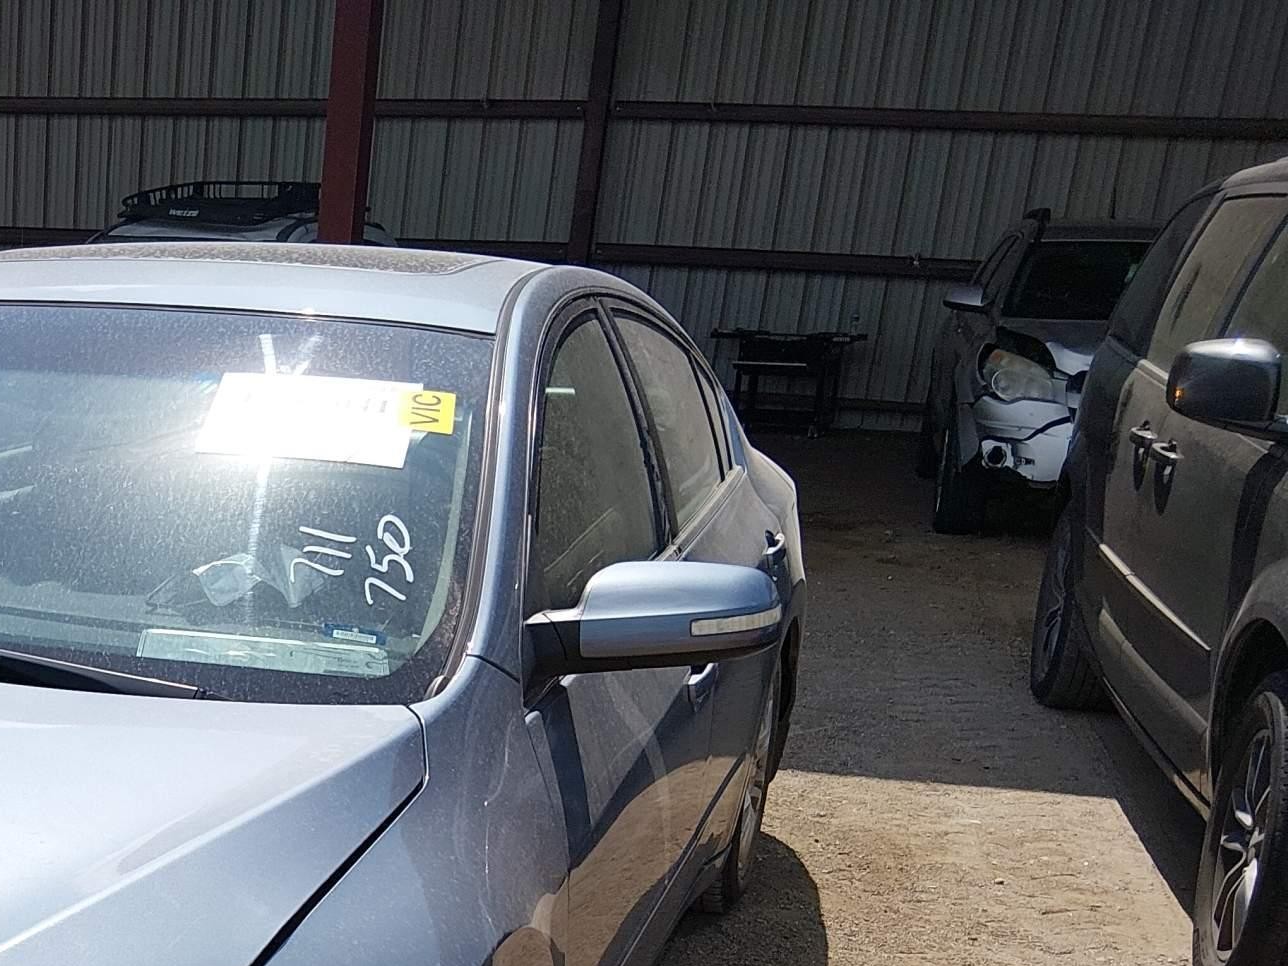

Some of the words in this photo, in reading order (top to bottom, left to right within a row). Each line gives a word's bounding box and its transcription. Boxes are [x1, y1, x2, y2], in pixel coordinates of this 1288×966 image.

[409, 393, 442, 426] VIC
[289, 526, 357, 583] 711
[364, 513, 414, 605] 750
